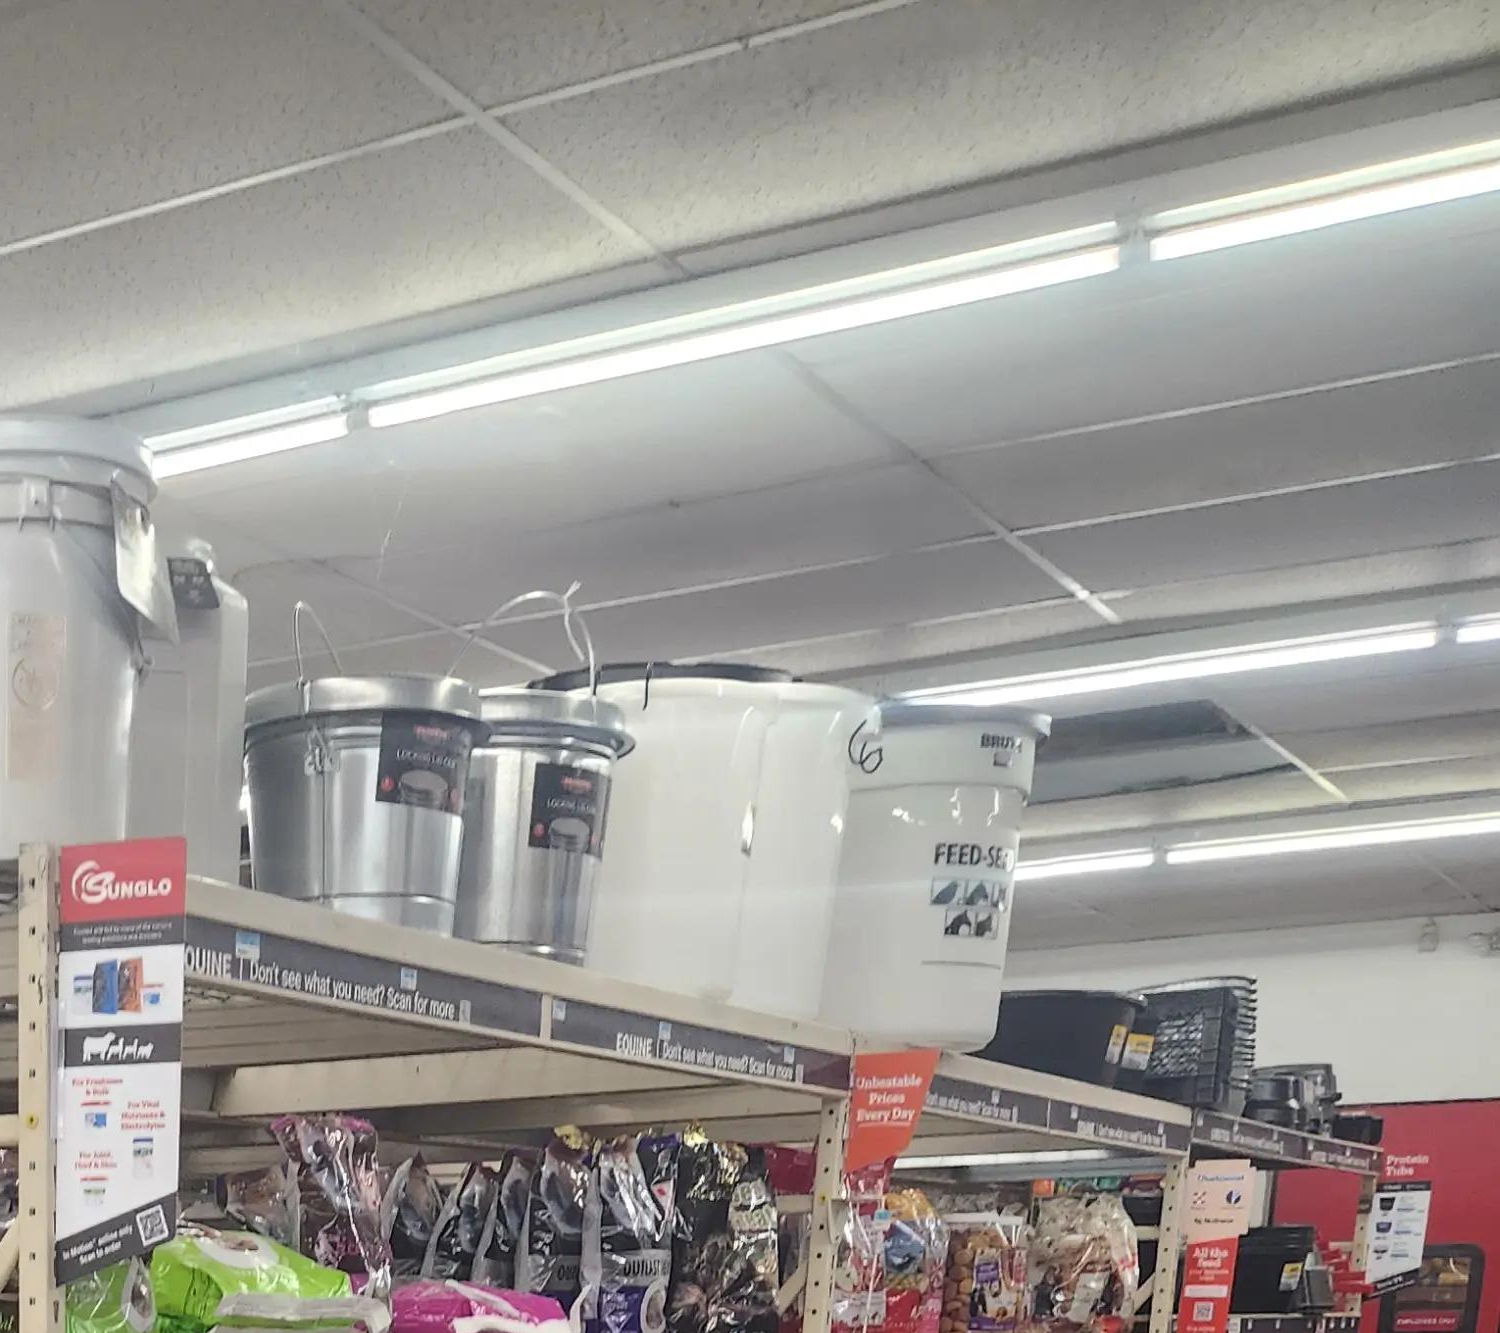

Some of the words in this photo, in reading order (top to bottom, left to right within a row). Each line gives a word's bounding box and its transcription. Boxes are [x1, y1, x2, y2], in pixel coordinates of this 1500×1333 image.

[77, 868, 173, 905] SUNGLO
[184, 946, 232, 978] QUINE
[250, 959, 280, 985] Don't
[282, 967, 301, 991] see
[304, 969, 331, 995] what
[332, 981, 352, 1000] you
[353, 983, 385, 1004] need?
[386, 986, 413, 1010] Scan
[413, 991, 429, 1014] for
[430, 1000, 456, 1019] more
[616, 1032, 653, 1058] EQUINE
[663, 1041, 683, 1059] Don't
[697, 1048, 714, 1066] what
[856, 1074, 923, 1090] Unbeatable
[868, 1091, 905, 1104] Prices
[856, 1107, 890, 1123] Every
[891, 1107, 916, 1122] Day
